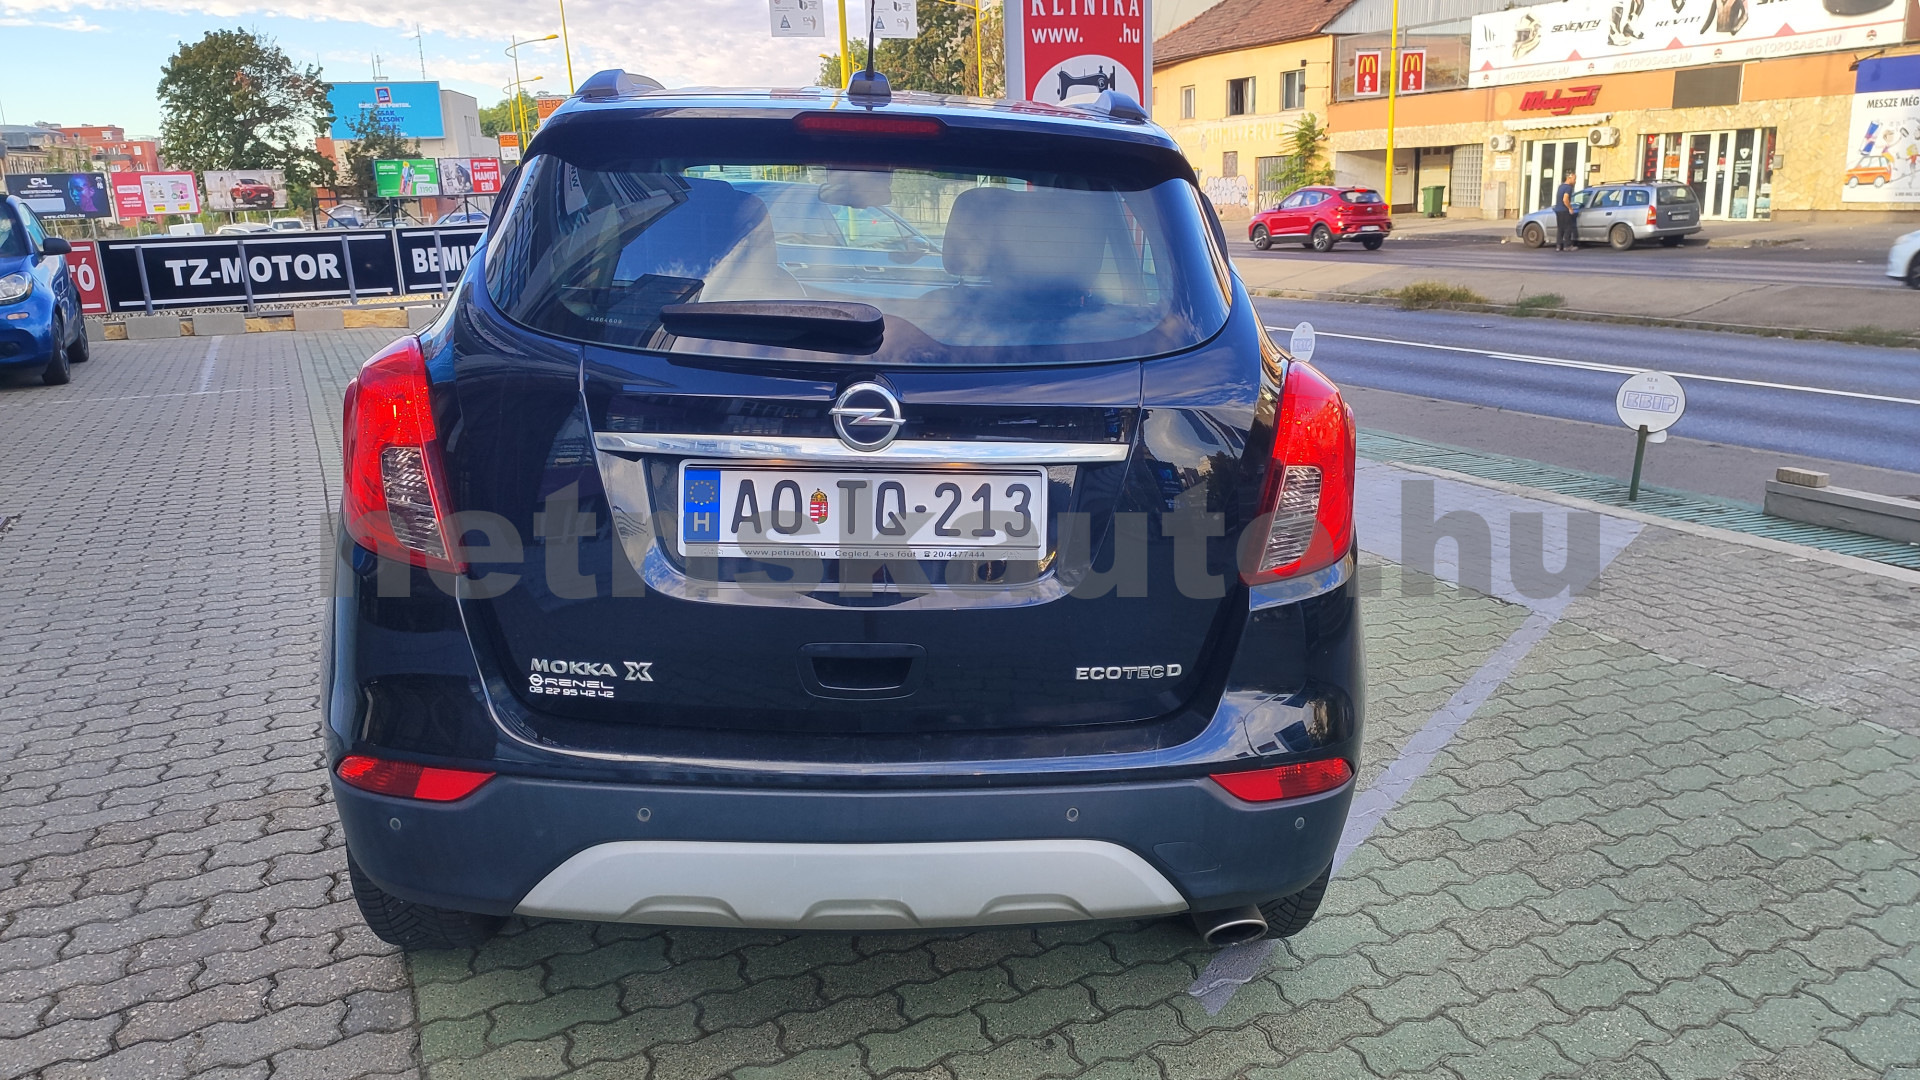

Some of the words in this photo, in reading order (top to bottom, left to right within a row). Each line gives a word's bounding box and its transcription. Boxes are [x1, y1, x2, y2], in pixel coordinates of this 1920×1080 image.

[1031, 27, 1084, 43] www.
[1118, 22, 1140, 43] .hu
[1551, 19, 1601, 33] SEVENTY
[1866, 98, 1899, 109] MESSZE
[1901, 95, 1920, 107] MÉG
[164, 253, 342, 287] TZ-MOTOR
[730, 478, 803, 535] AO
[836, 479, 1032, 538] TQ-213
[693, 511, 711, 533] H
[744, 549, 826, 558] www.petiauto.hu
[874, 550, 894, 558] 4-es
[530, 658, 617, 677] MOKKA
[623, 660, 654, 682] X
[1075, 665, 1165, 680] ECOTEC
[563, 688, 578, 696] 95
[580, 689, 596, 697] 42
[598, 690, 614, 698] 42
